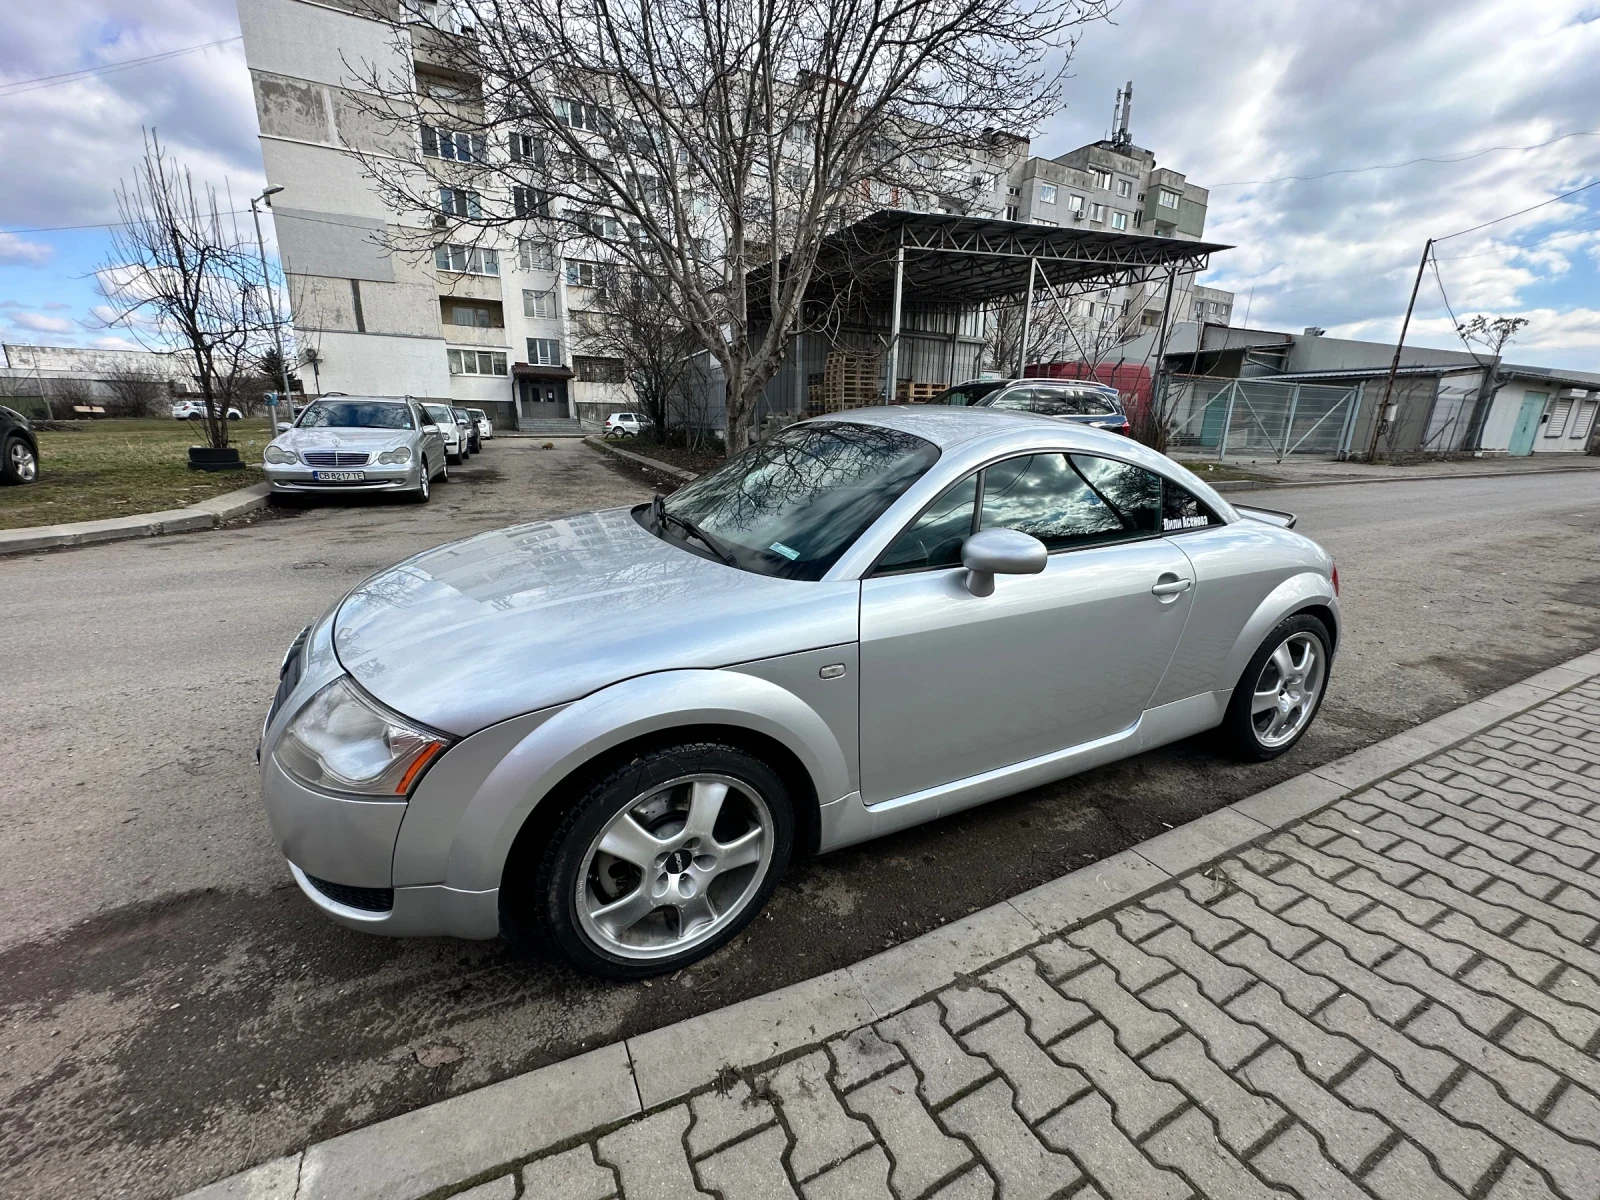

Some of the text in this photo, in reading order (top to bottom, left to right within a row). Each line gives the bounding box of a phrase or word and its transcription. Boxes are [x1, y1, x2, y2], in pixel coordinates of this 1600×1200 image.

[318, 472, 330, 480] CB
[331, 472, 350, 480] 8217
[351, 472, 363, 480] TE
[1163, 515, 1208, 531] Лили Асенова
